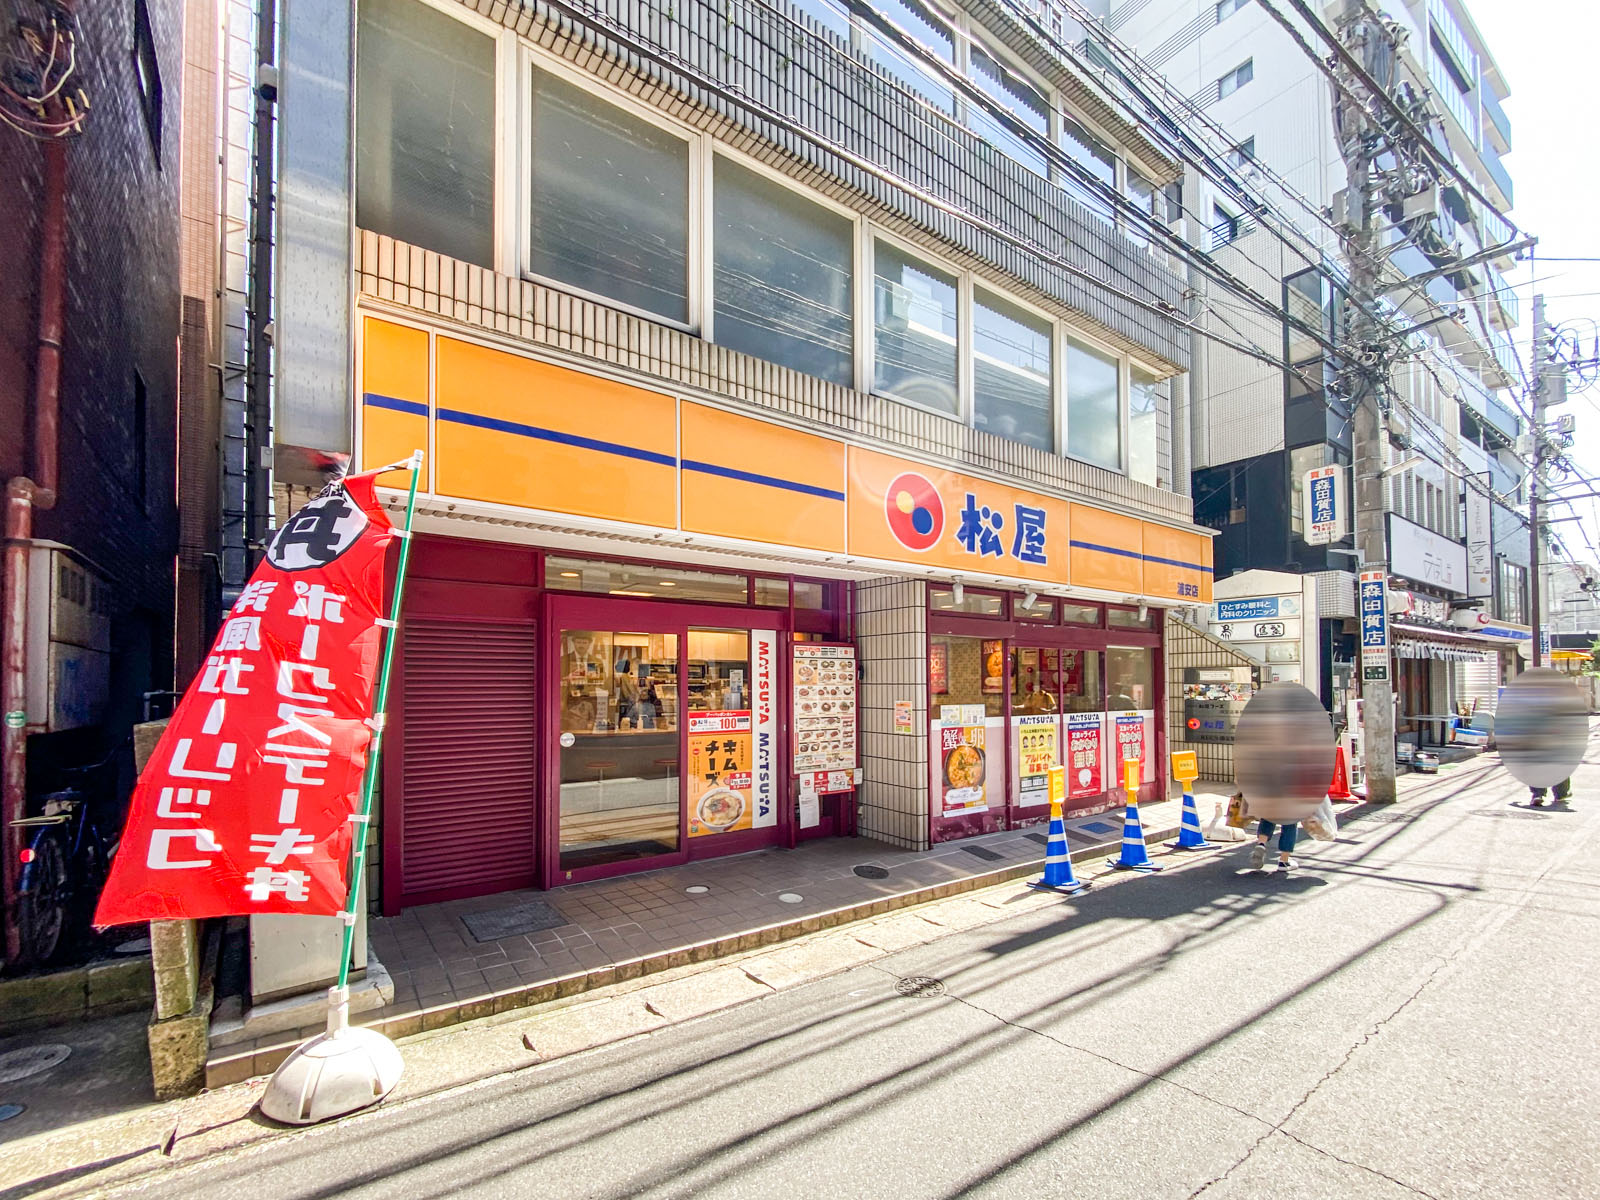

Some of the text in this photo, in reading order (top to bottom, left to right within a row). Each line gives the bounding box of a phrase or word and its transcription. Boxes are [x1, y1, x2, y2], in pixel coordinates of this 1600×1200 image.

[1314, 480, 1332, 521] 森田質店
[956, 492, 1047, 566] 松屋
[1177, 582, 1199, 597] 浦安店
[1221, 608, 1277, 619] 内科のクリニック
[1363, 584, 1384, 643] 森田質店
[720, 718, 737, 729] 100
[705, 740, 720, 788] チーズ
[723, 740, 738, 771] キム
[1025, 753, 1052, 764] アルバイト
